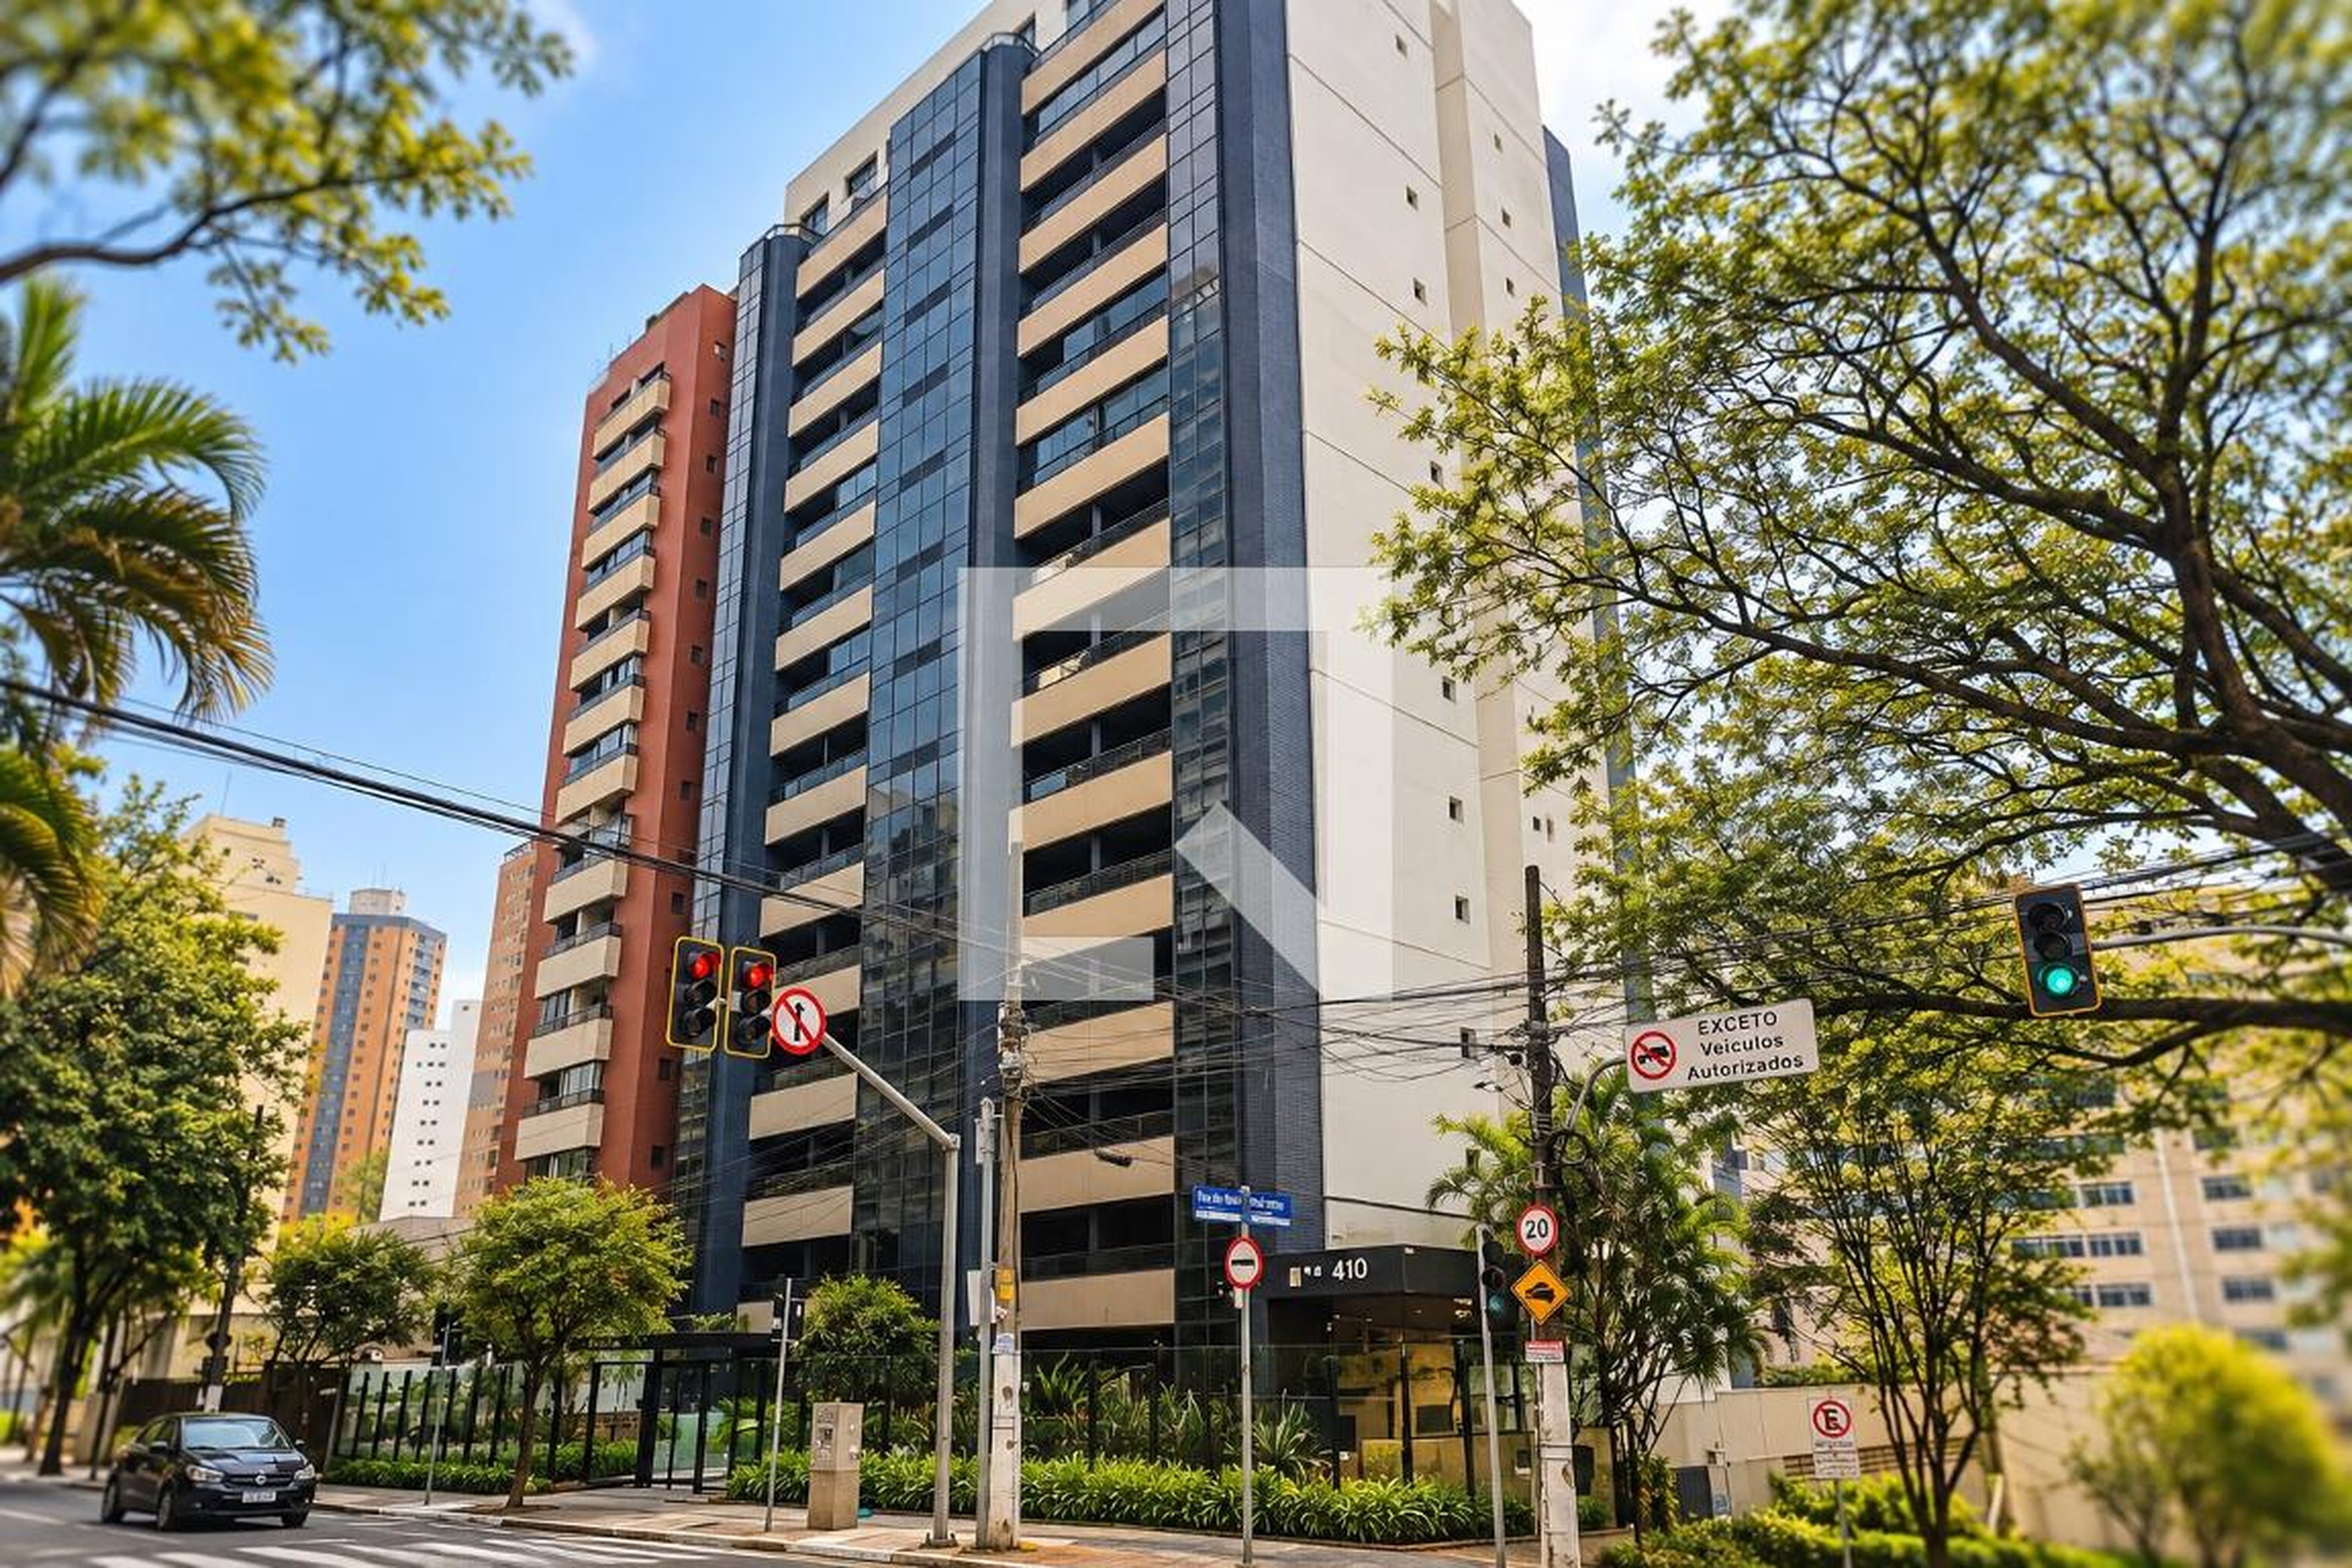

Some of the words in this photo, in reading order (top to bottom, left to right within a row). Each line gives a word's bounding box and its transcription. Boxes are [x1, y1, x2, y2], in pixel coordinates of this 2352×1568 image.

[1698, 1011, 1777, 1035] EXCETO
[1687, 1055, 1804, 1080] Autorizados
[1526, 1218, 1549, 1239] 20
[1332, 1257, 1368, 1280] 410
